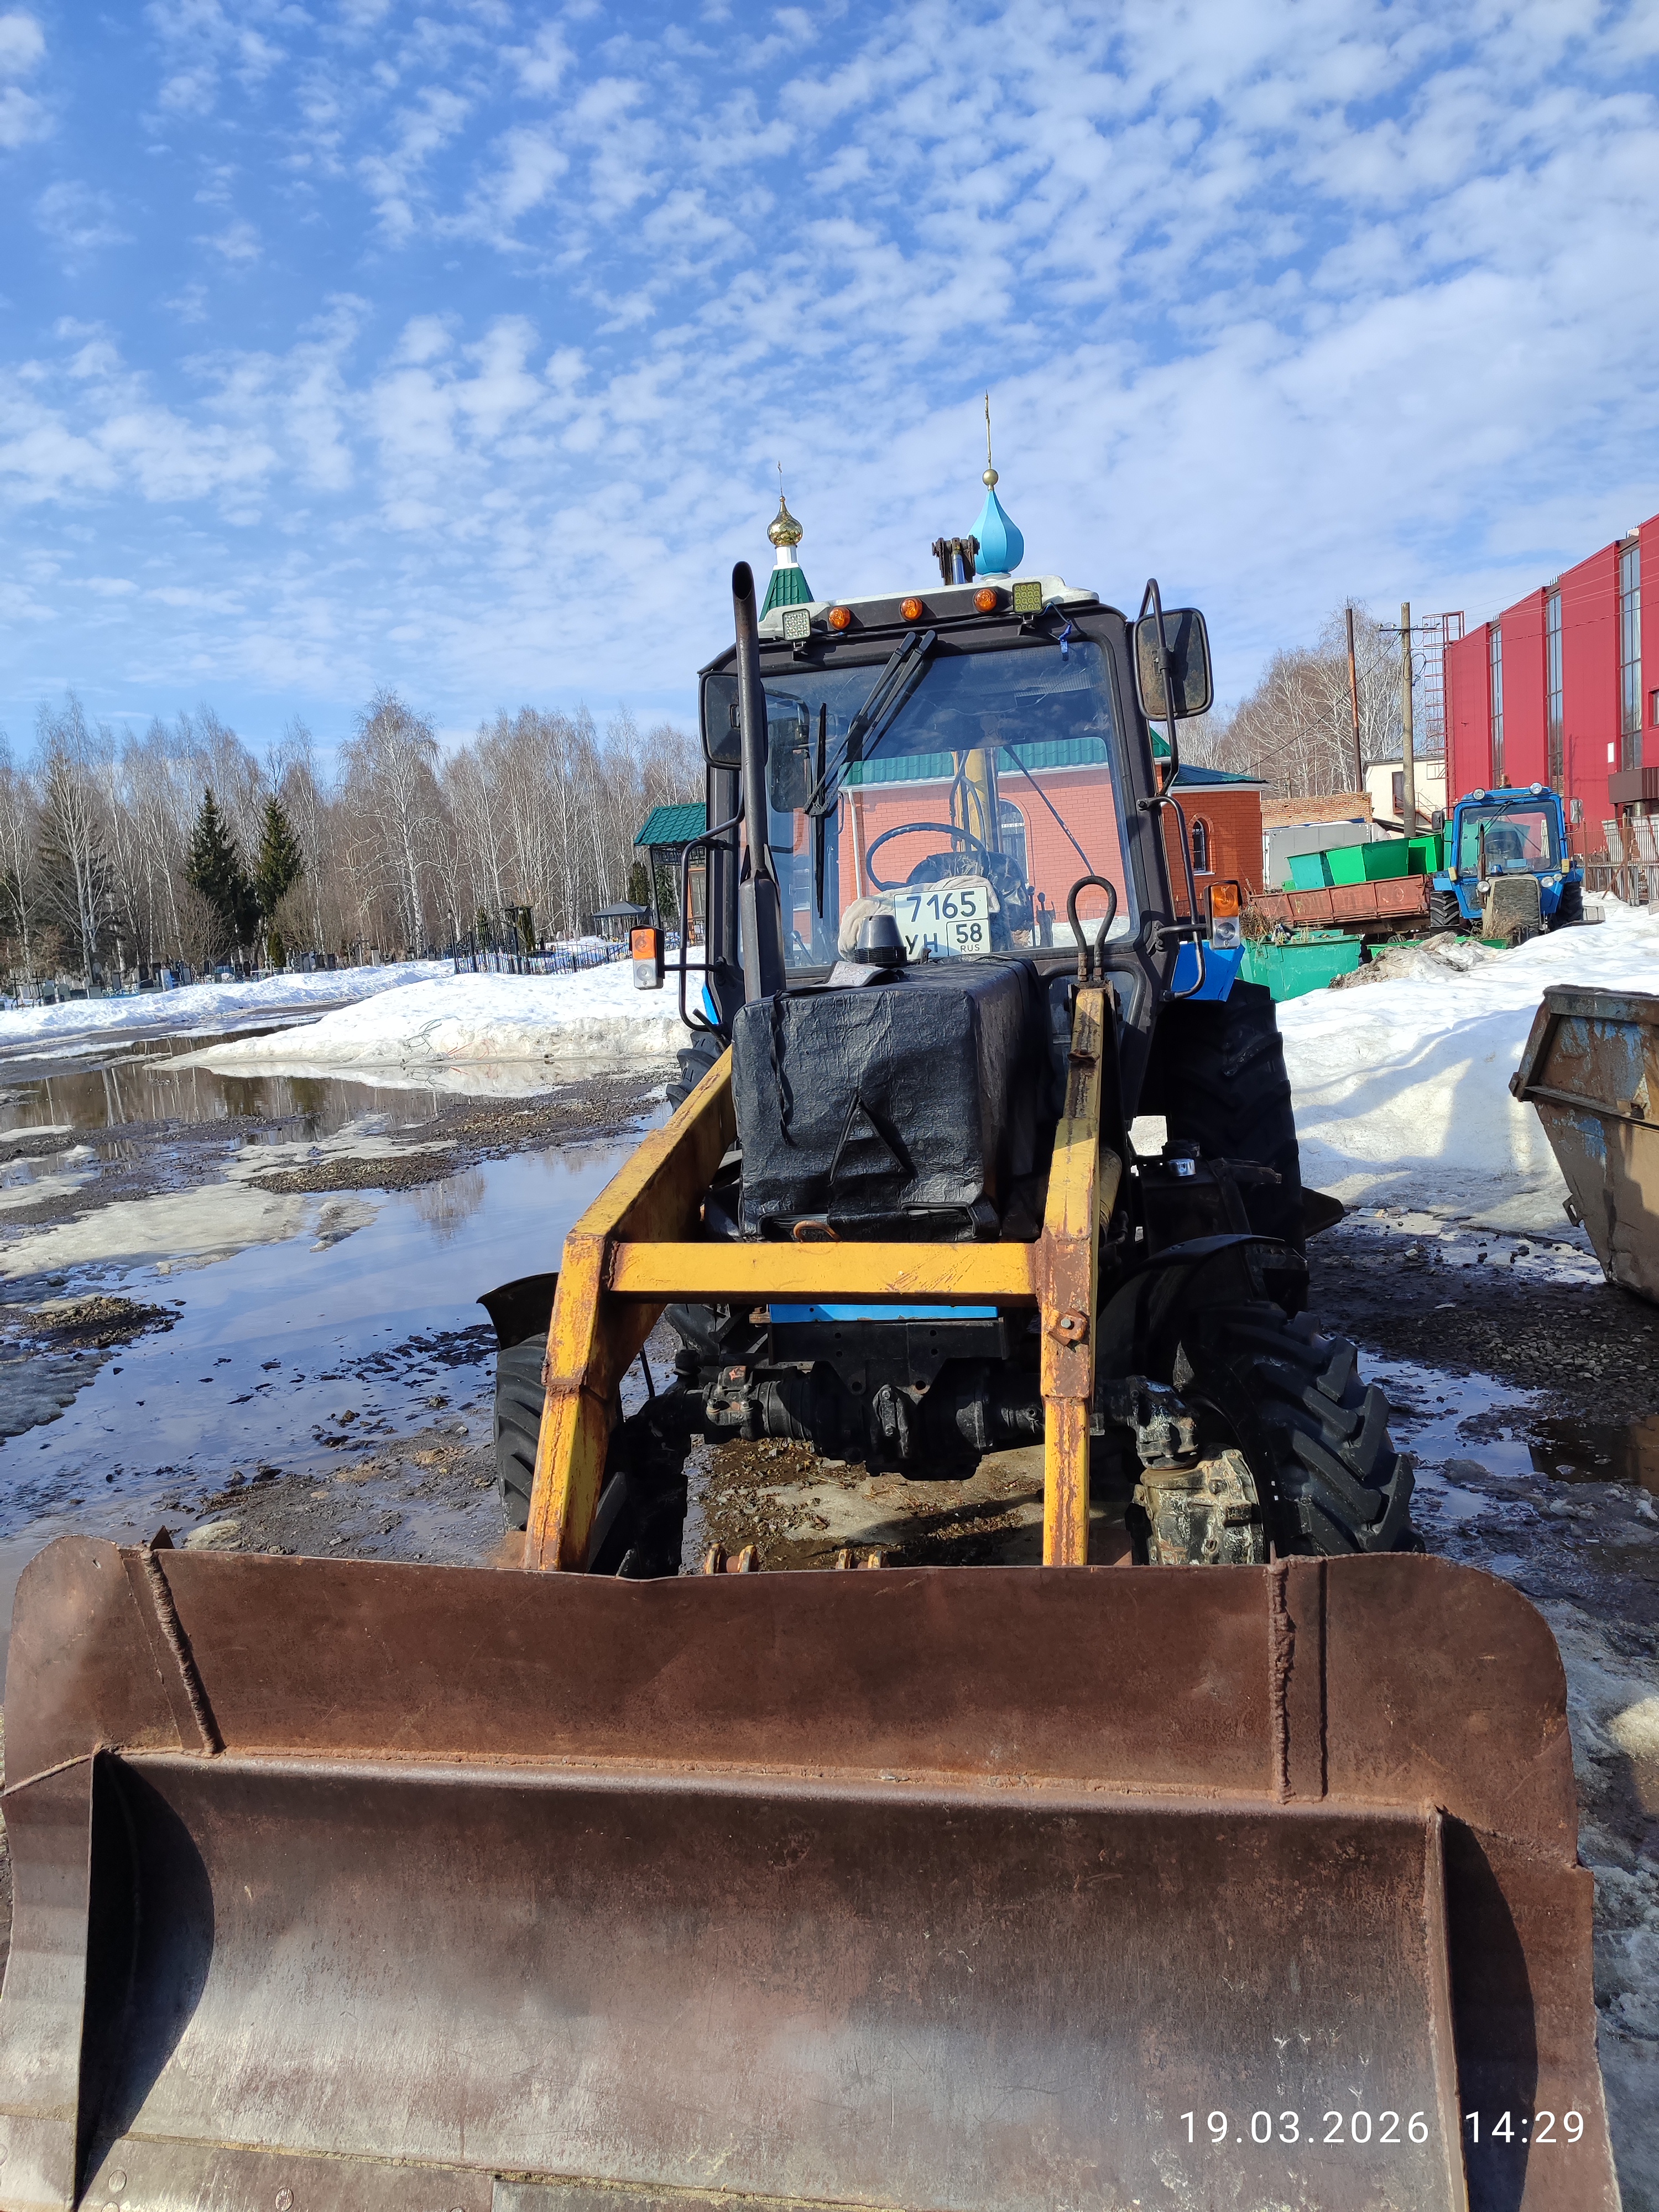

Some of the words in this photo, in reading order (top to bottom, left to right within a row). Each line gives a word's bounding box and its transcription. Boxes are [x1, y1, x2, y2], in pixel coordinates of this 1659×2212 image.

[906, 890, 976, 922] 7165
[905, 932, 938, 955] УН
[956, 922, 983, 944] 58
[960, 944, 980, 952] RUS
